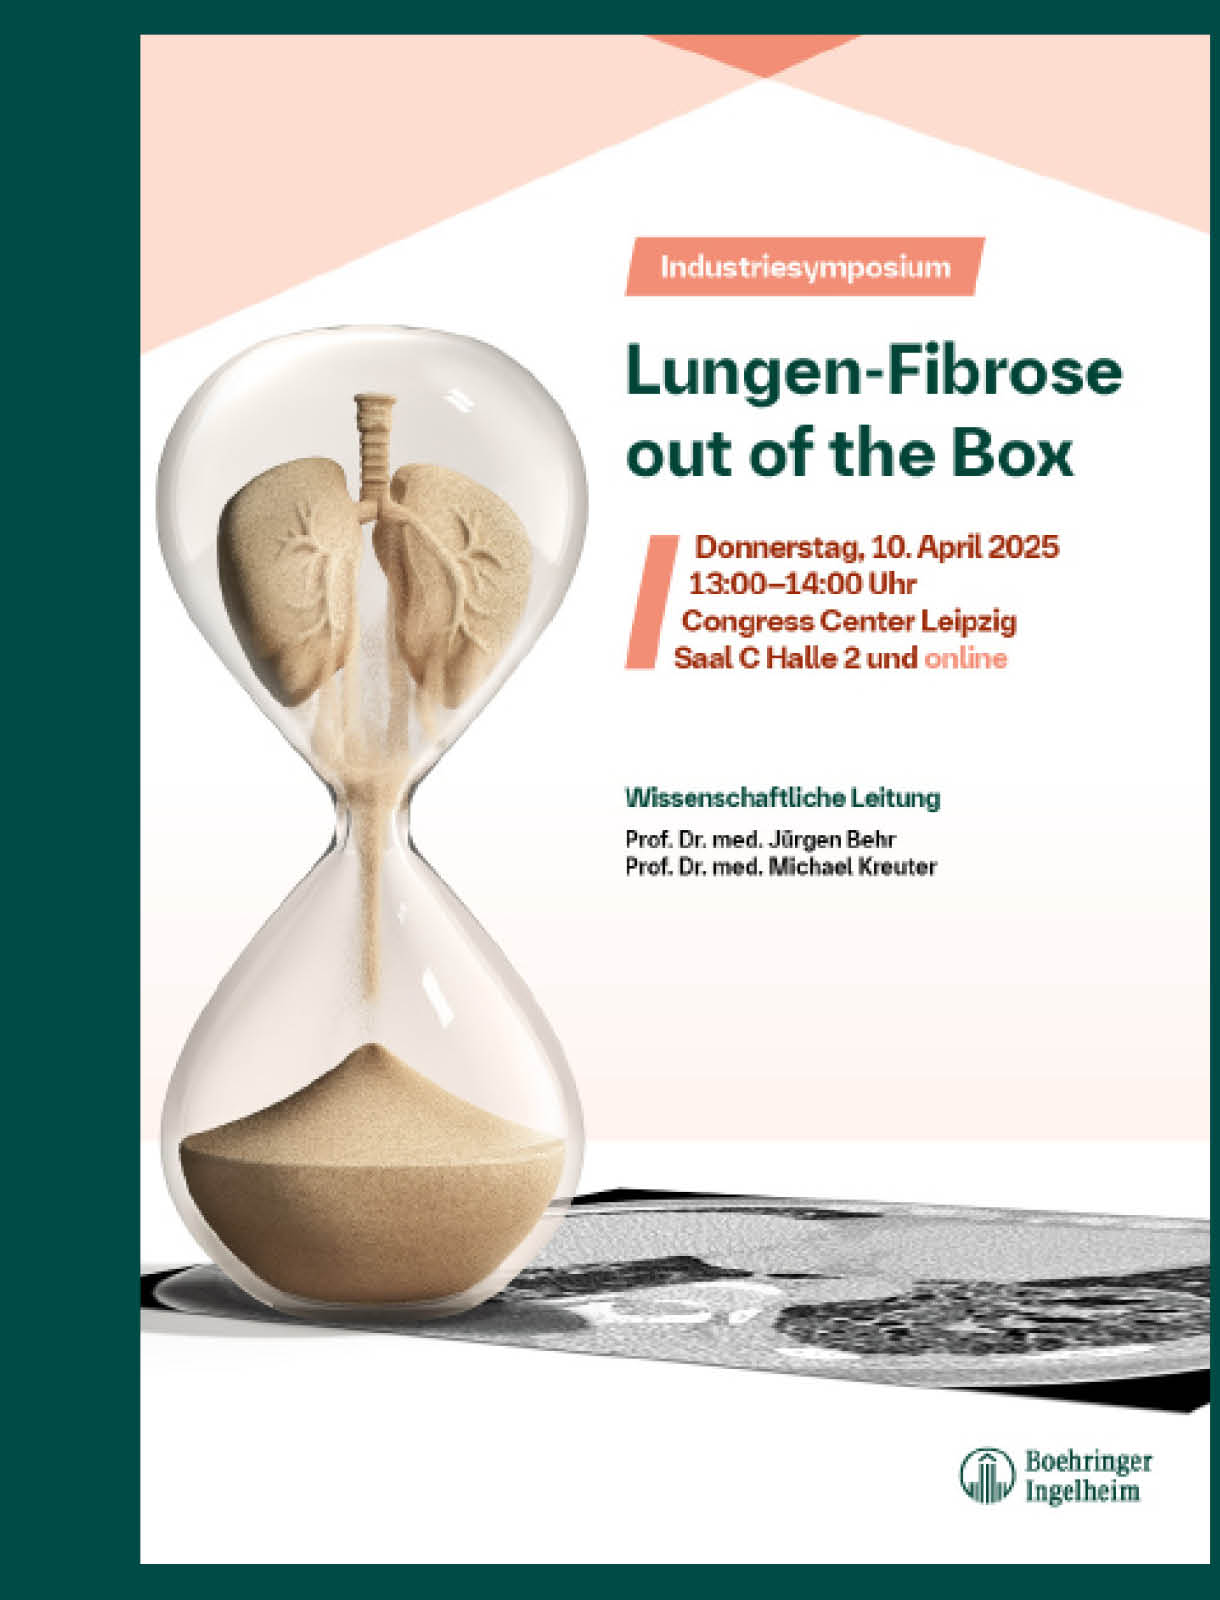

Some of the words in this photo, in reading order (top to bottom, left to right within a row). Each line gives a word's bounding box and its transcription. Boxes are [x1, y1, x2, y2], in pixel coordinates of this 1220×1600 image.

[661, 253, 951, 284] Industriesymposium
[626, 340, 1124, 408] Lungen-Fibrose
[627, 431, 732, 478] out
[749, 424, 815, 478] of
[828, 424, 936, 478] the
[953, 427, 1075, 478] Box
[696, 535, 864, 564] Donnerstag,
[872, 535, 912, 559] 10.
[917, 532, 983, 563] April
[988, 535, 1060, 559] 2025
[689, 571, 864, 595] 13:00–14:00
[869, 571, 918, 595] Uhr
[682, 609, 815, 637] Congress
[820, 609, 916, 633] Center
[922, 607, 1017, 637] Leipzig
[675, 645, 734, 669] Saal
[739, 645, 760, 669] C
[767, 645, 838, 669] Halle
[843, 646, 861, 669] 2
[866, 645, 918, 669] und
[925, 645, 1008, 669] online
[625, 786, 847, 808] Wissenschaftliche
[850, 786, 941, 812] Leitung
[626, 830, 674, 849] Prof.
[679, 830, 707, 849] Dr.
[712, 830, 763, 849] med.
[768, 830, 842, 852] Jürgen
[846, 830, 897, 849] Behr
[626, 856, 674, 876] Prof.
[679, 856, 707, 876] Dr.
[712, 856, 763, 876] med.
[769, 856, 854, 876] Michael
[858, 856, 938, 876] Kreuter
[1025, 1448, 1154, 1477] Boehringer
[1025, 1479, 1141, 1508] Ingelheim
